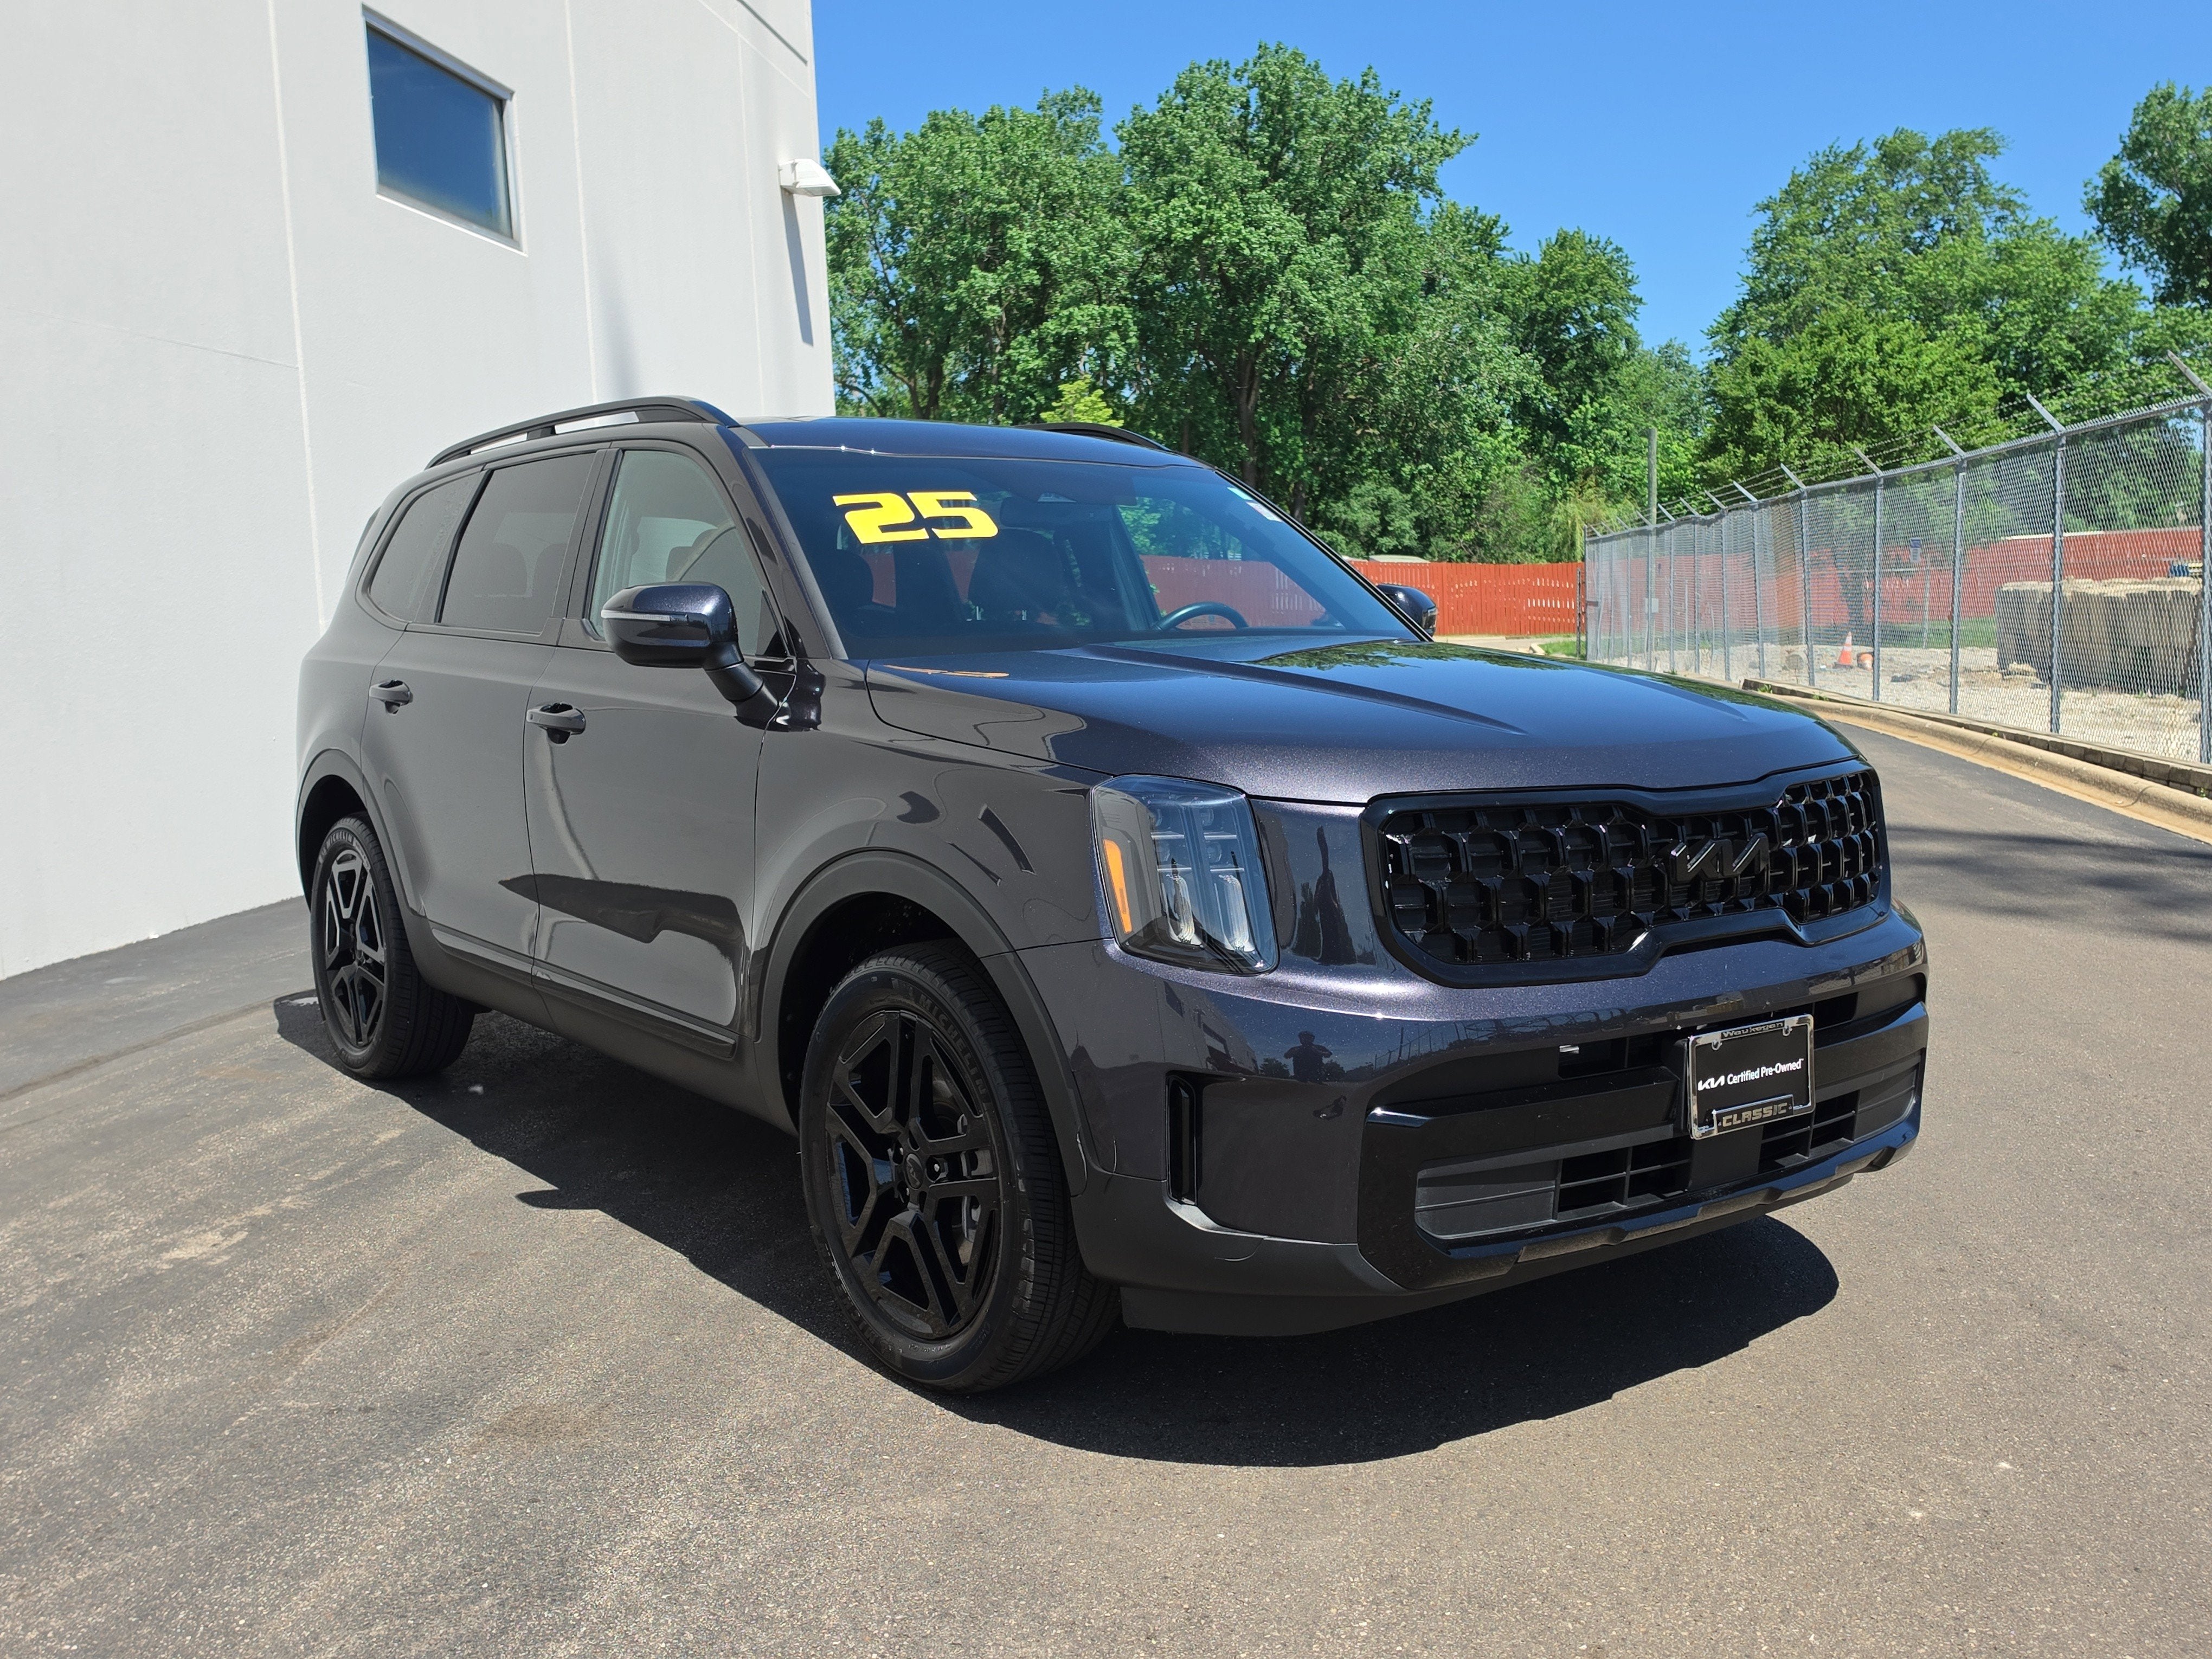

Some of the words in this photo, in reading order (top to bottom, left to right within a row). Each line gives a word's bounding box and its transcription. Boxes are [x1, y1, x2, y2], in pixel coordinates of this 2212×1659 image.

[833, 491, 998, 544] 25
[919, 994, 987, 1095] MICHELIN
[1722, 1022, 1783, 1038] Waukegan
[1697, 1075, 1725, 1091] KIA
[1727, 1068, 1760, 1085] Certified
[1761, 1059, 1802, 1077] Pre-Owned
[1722, 1102, 1787, 1127] CLASSIC
